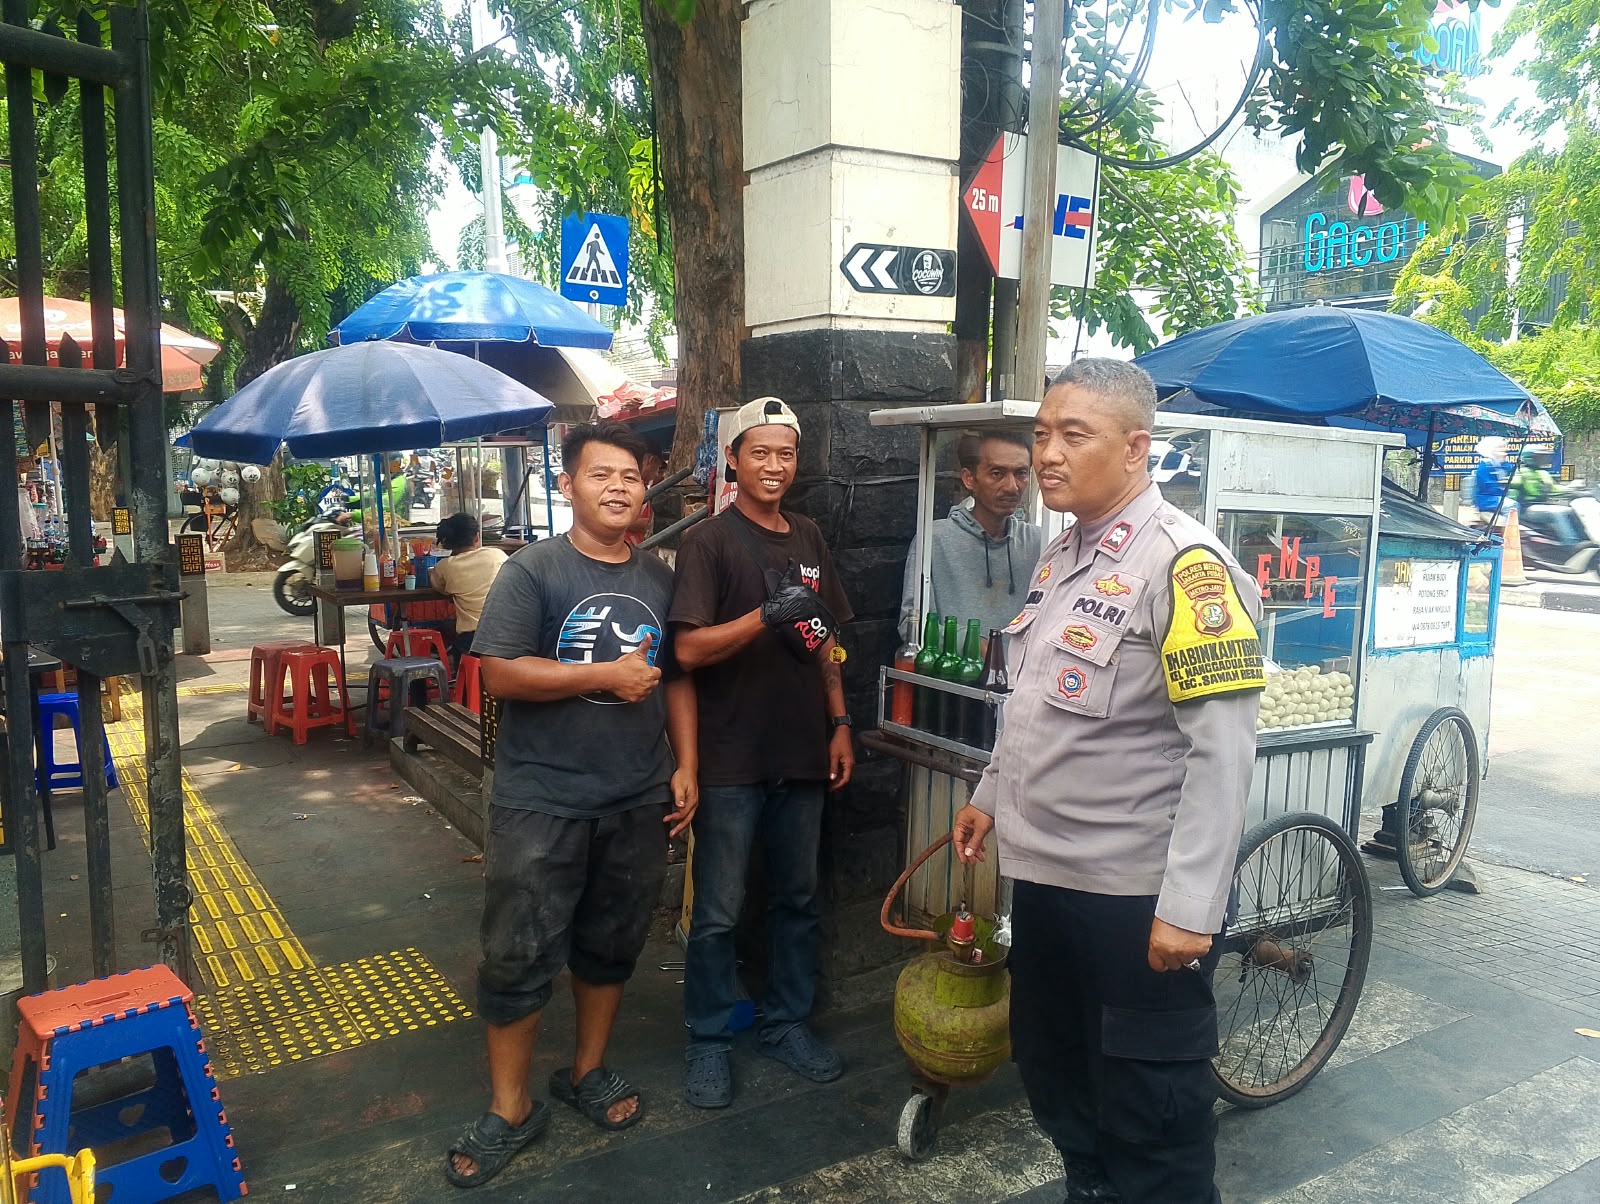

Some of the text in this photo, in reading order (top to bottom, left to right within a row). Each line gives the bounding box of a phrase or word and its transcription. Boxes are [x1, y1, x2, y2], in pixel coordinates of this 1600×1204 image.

[971, 187, 999, 213] 25 m
[799, 563, 820, 580] kopi
[1178, 563, 1223, 579] POLRES METRO
[1072, 597, 1127, 626] POLRI
